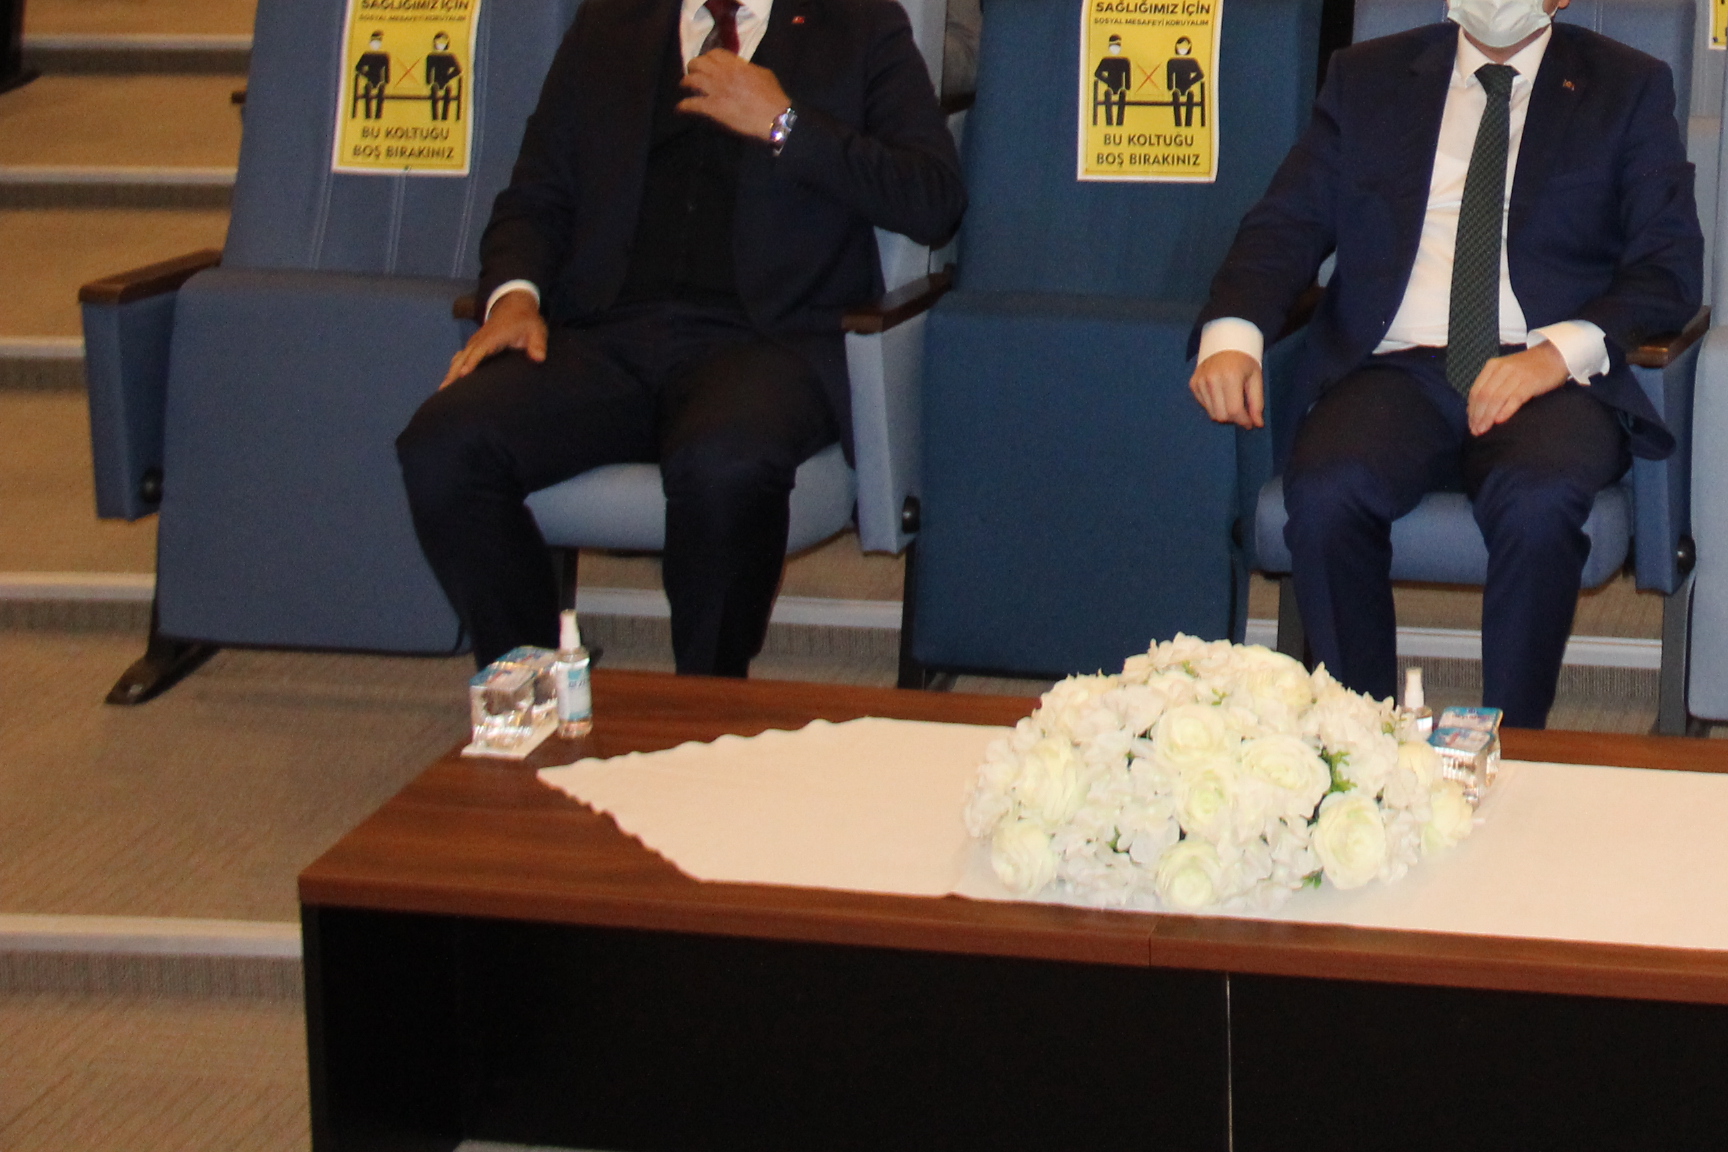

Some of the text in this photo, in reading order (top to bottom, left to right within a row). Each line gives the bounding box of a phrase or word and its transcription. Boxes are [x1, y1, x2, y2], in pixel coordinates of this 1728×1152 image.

[1096, 0, 1211, 17] SAĞLIĞIMIZ İÇİN
[362, 128, 380, 139] BU
[1104, 132, 1194, 147] BU KOLTUĞU
[354, 146, 454, 160] BOŞ BIRAKINIZ
[1097, 153, 1200, 168] BOŞ BIRAKINIZ
